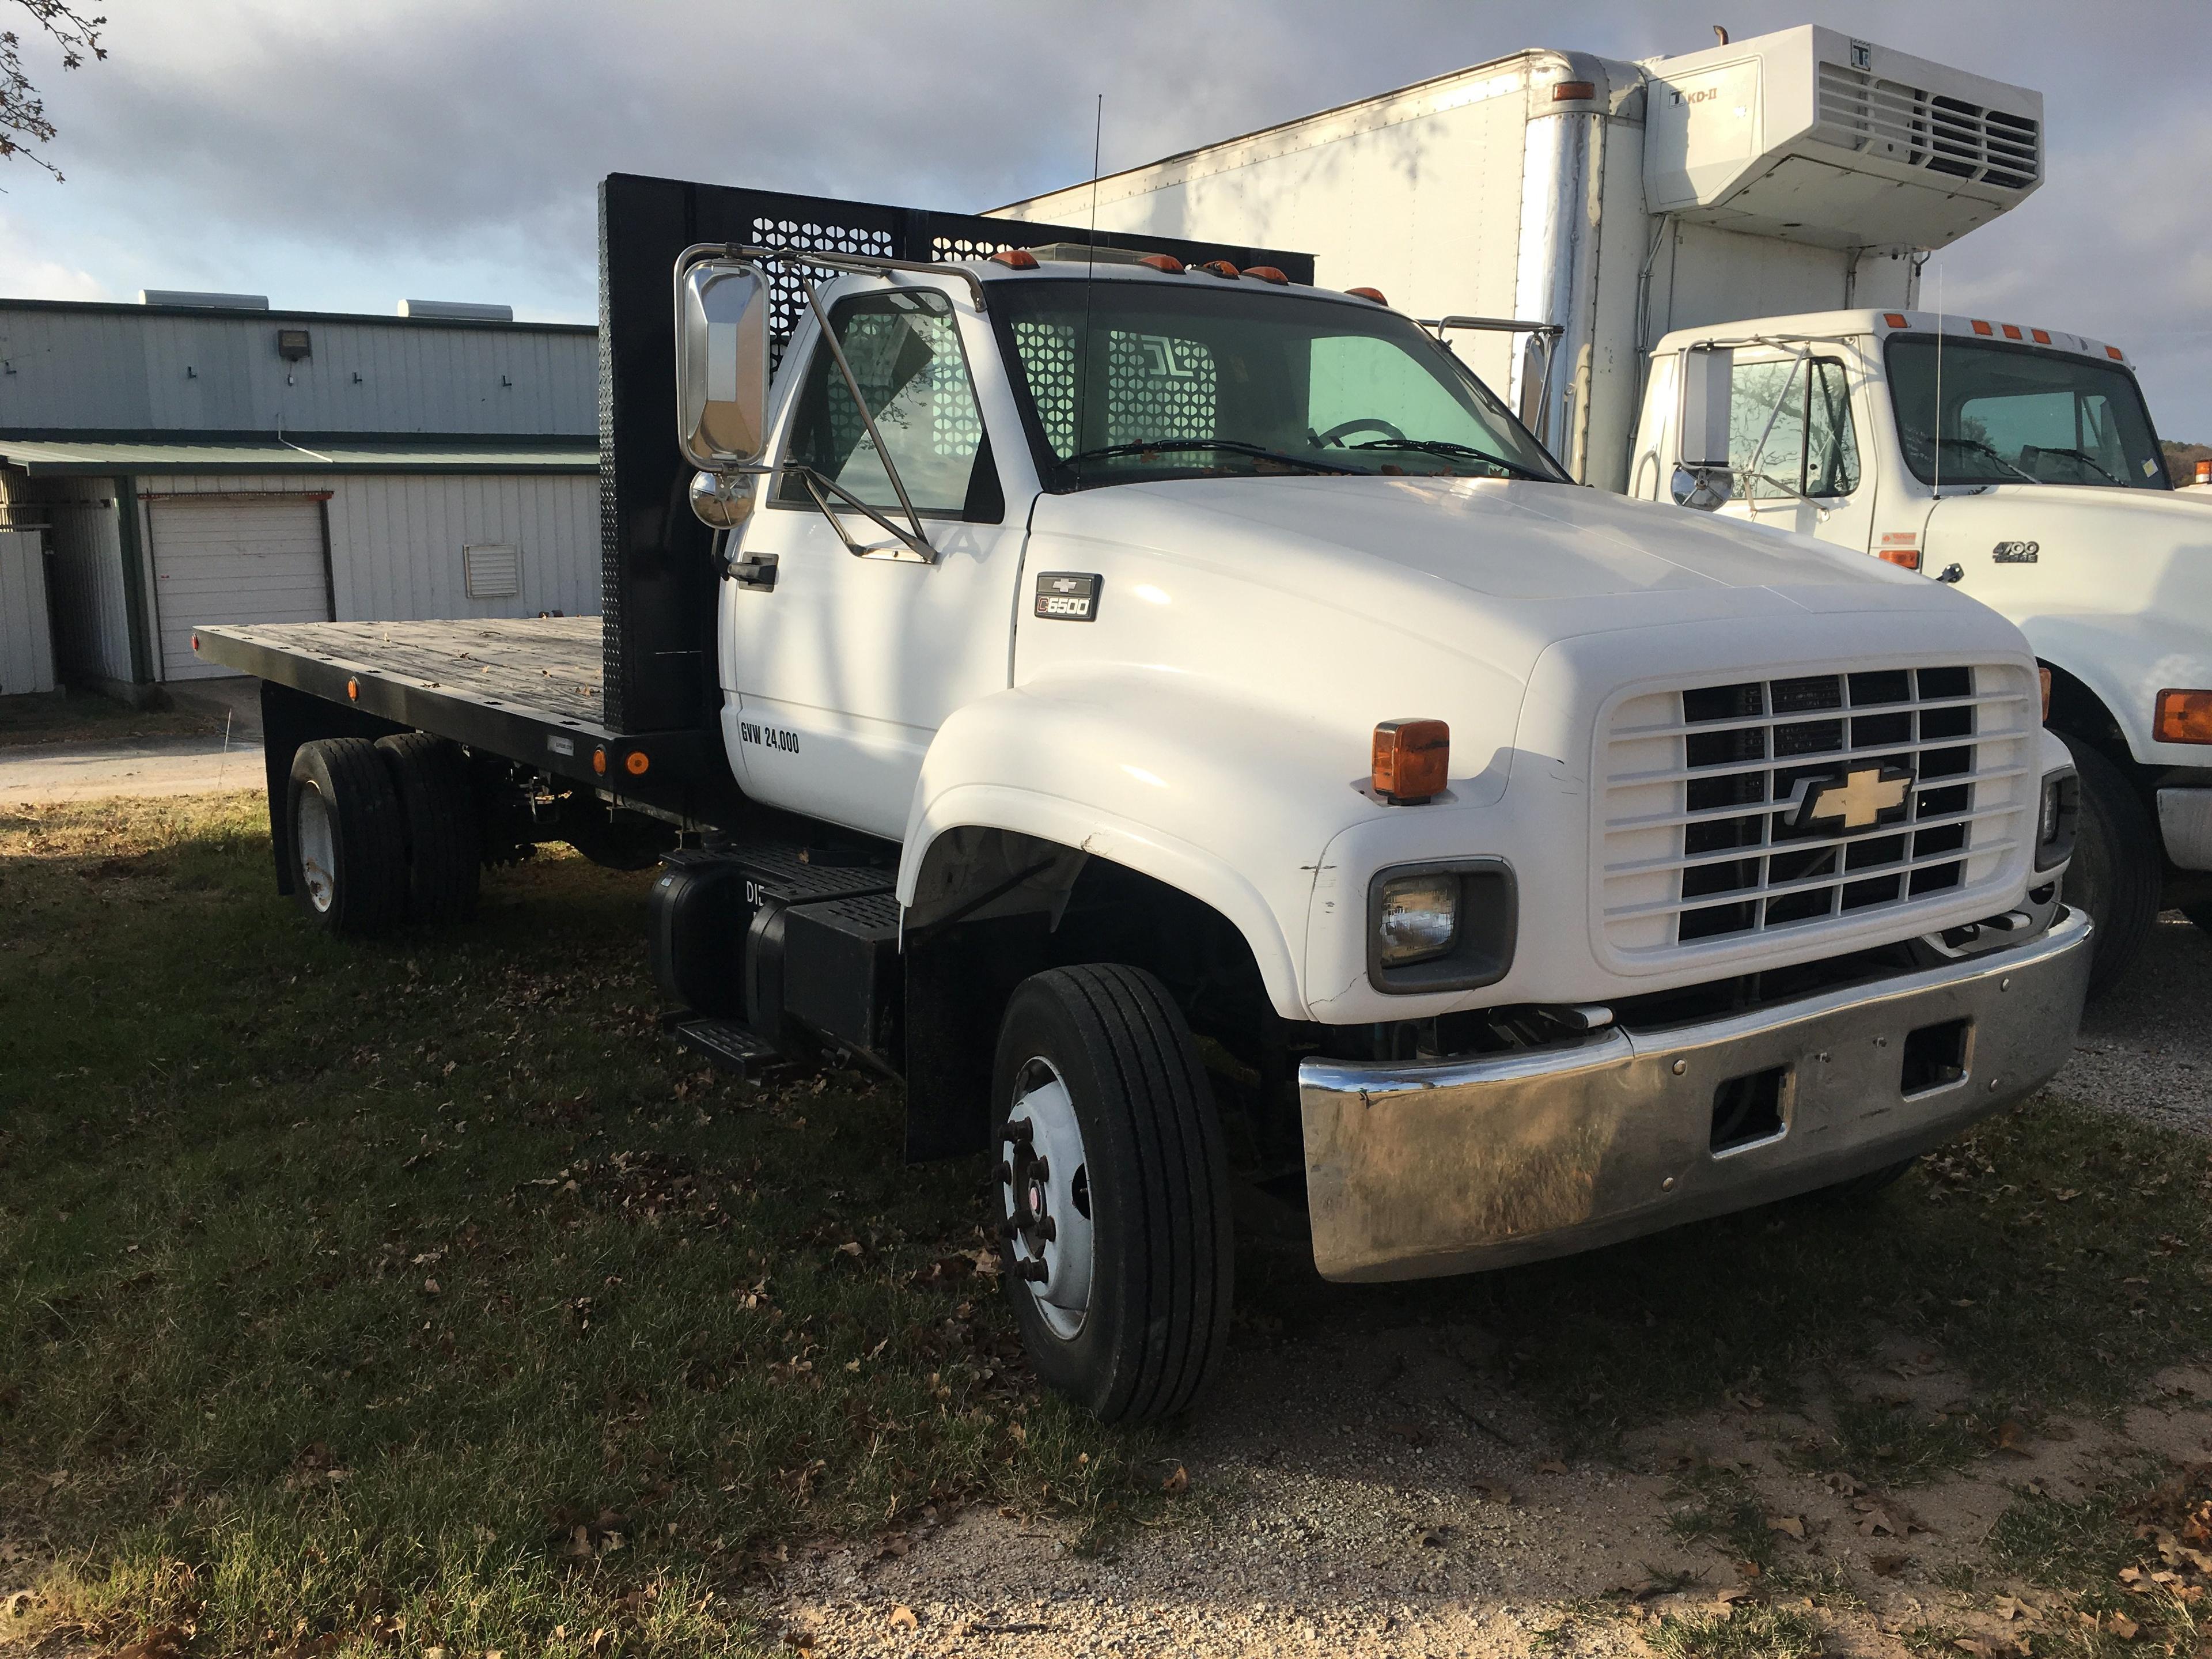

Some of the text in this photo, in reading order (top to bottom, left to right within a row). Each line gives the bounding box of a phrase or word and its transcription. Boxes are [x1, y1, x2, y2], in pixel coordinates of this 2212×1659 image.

[1993, 541, 2039, 555] 4700
[1037, 597, 1089, 615] C6500
[741, 722, 800, 753] GVW 24,000
[747, 881, 764, 906] DIE
